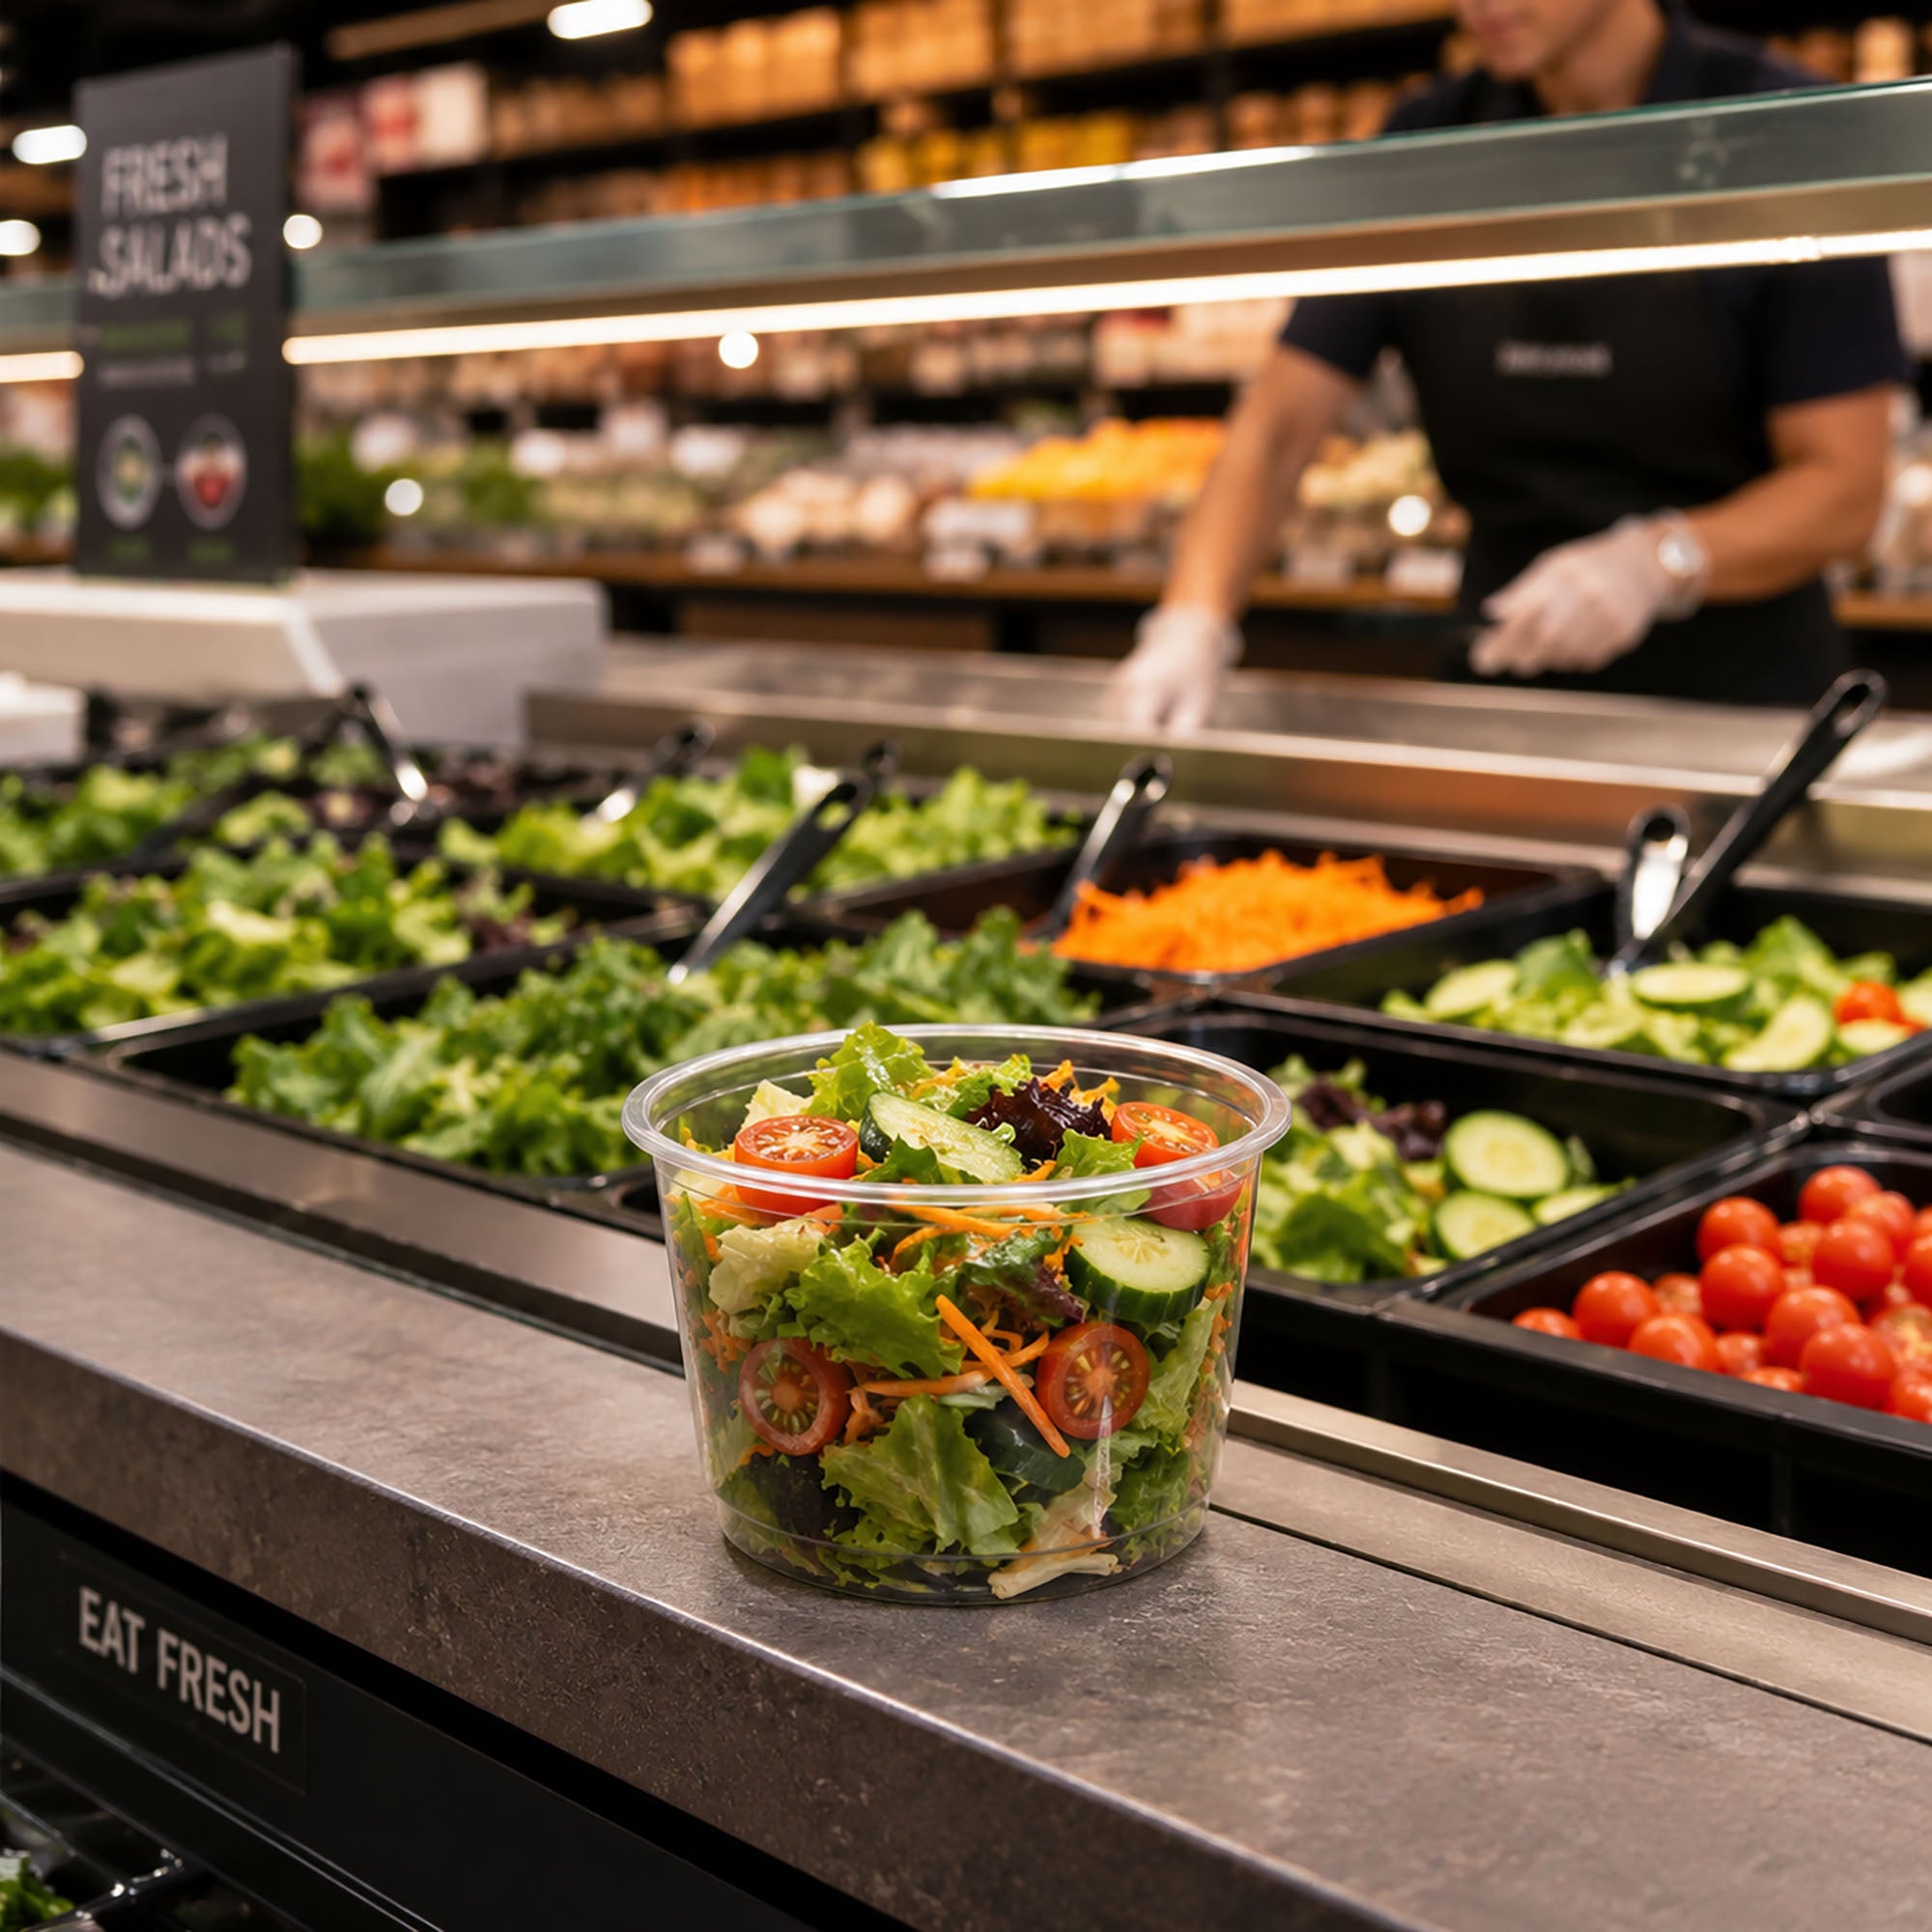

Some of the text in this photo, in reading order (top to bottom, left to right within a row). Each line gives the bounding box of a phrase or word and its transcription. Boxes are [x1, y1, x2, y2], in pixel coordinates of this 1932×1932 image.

[100, 132, 230, 218] FRESH
[88, 211, 252, 299] SALADS
[79, 1584, 280, 1754] EAT FRESH
